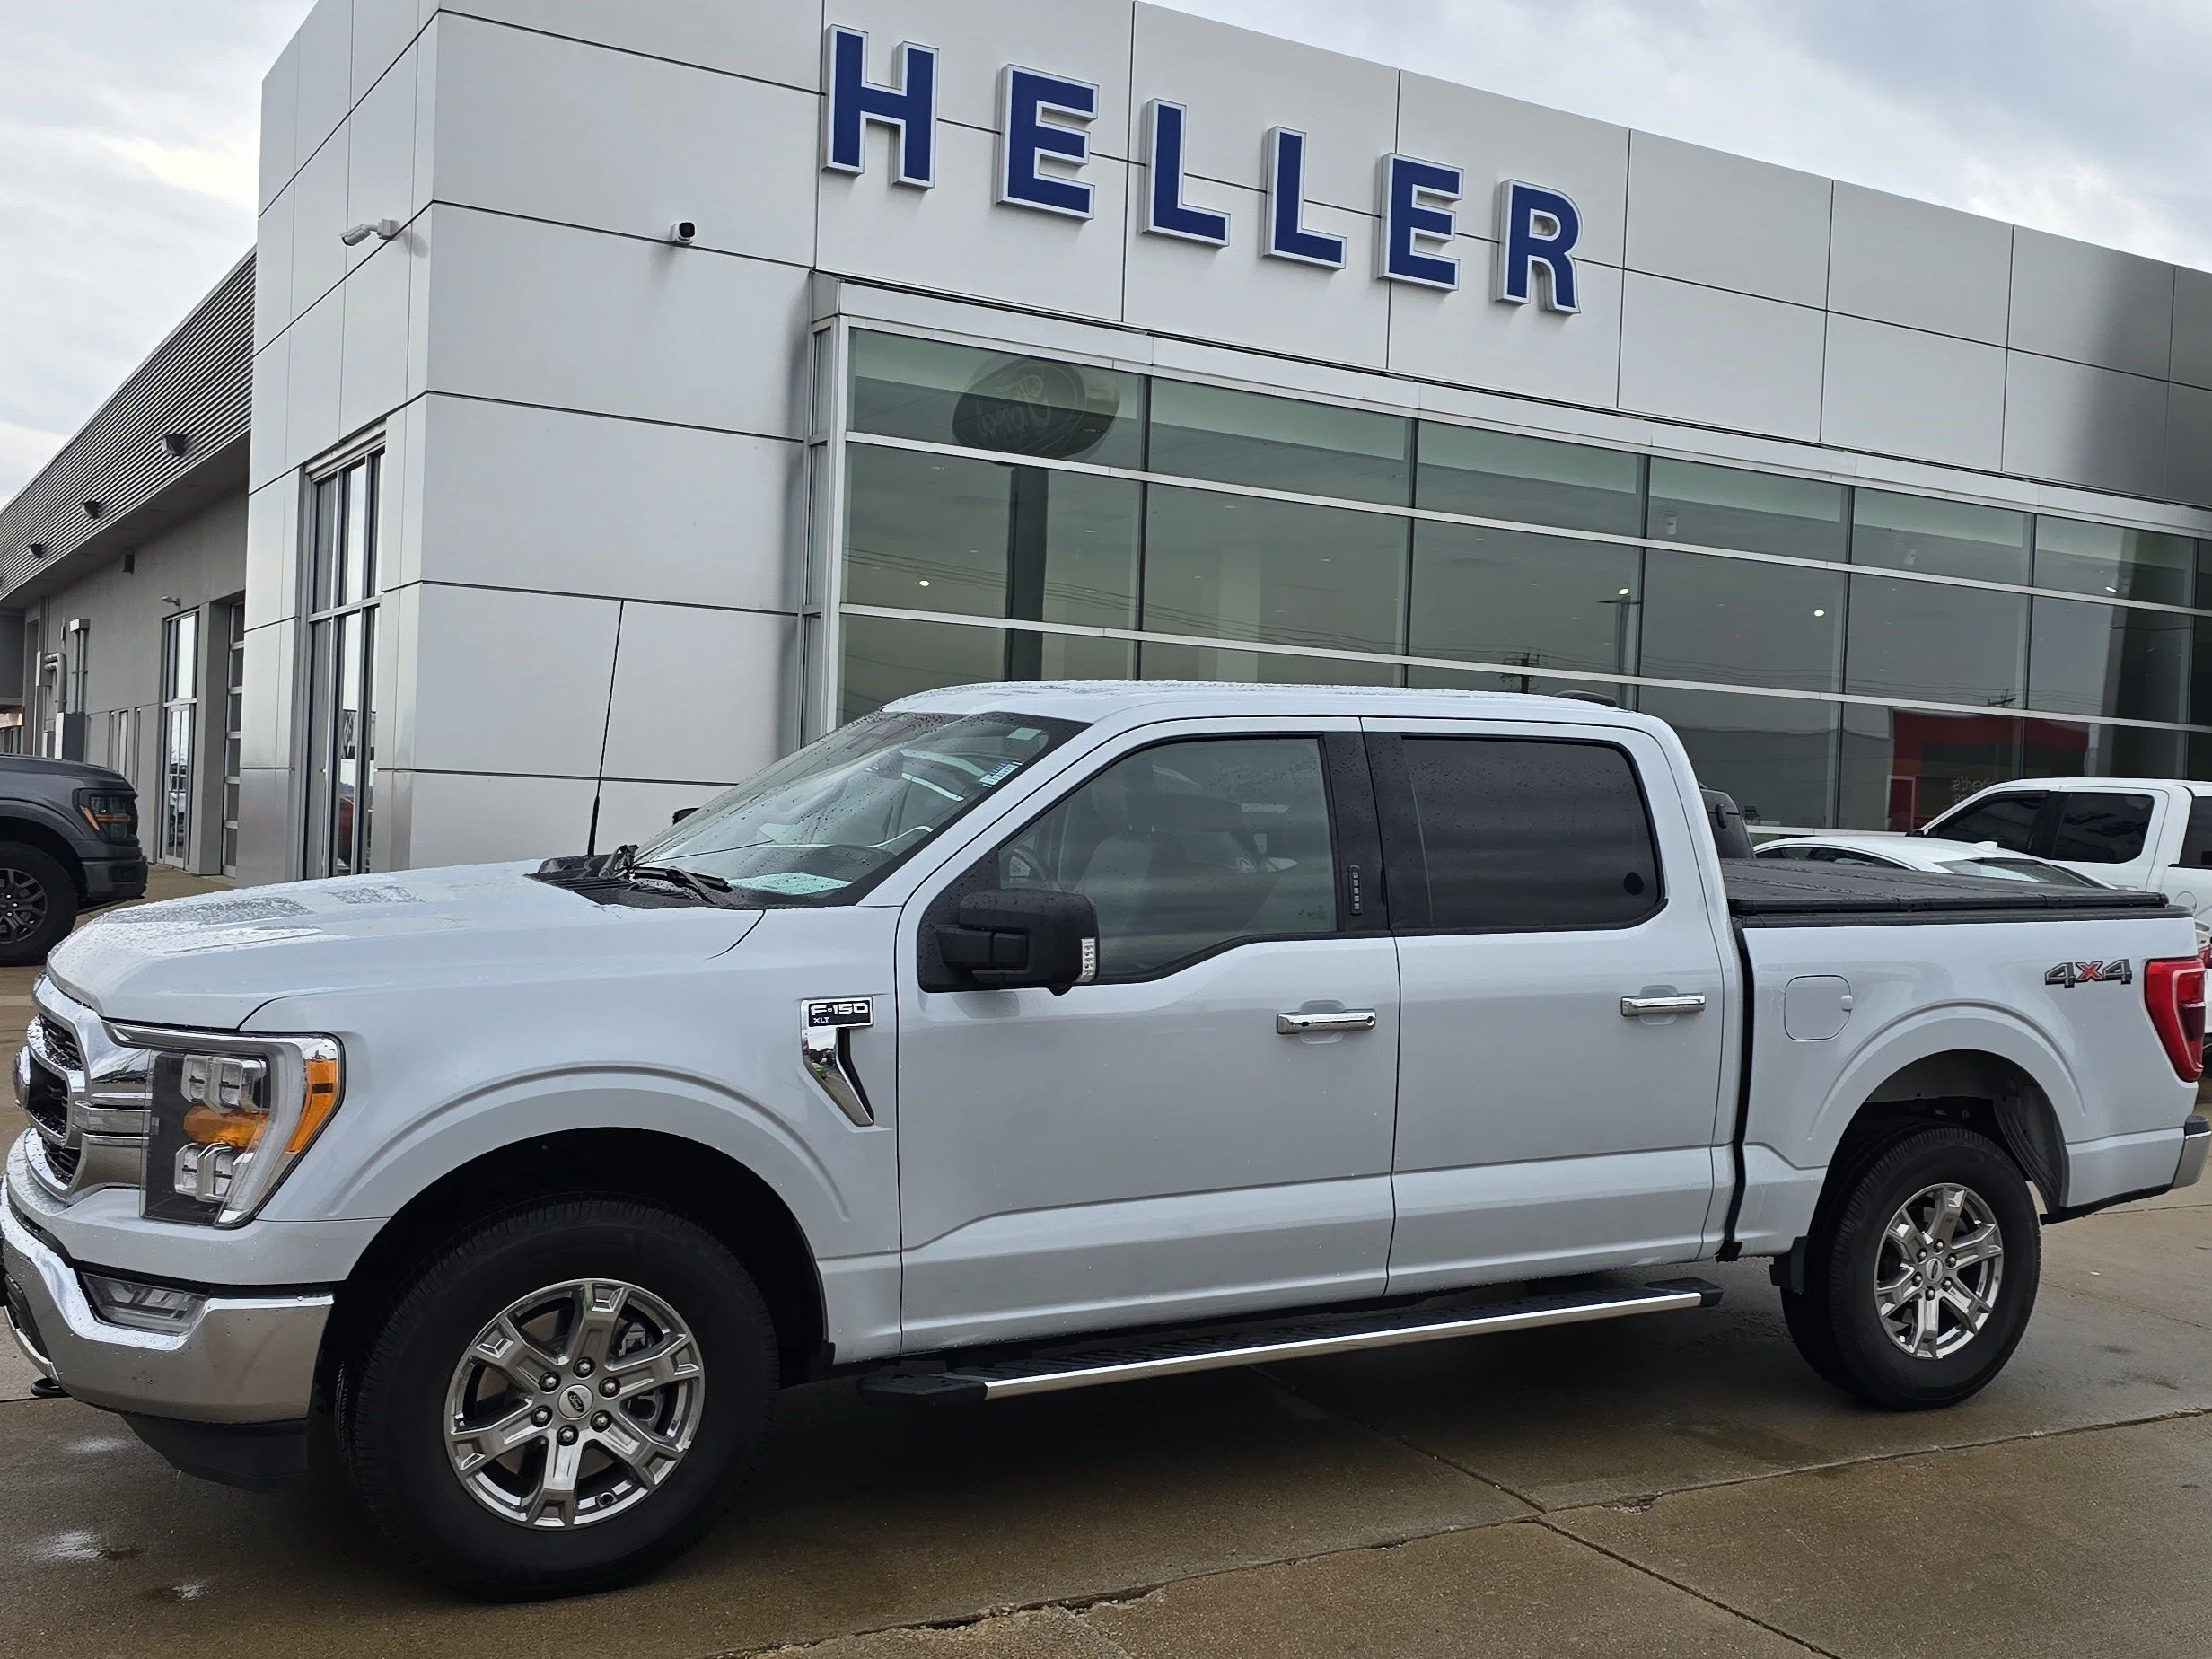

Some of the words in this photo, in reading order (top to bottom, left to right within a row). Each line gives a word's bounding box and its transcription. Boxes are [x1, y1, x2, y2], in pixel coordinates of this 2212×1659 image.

[822, 24, 1584, 316] HELLER
[811, 1003, 868, 1015] F-150
[568, 1393, 584, 1411] Ford
